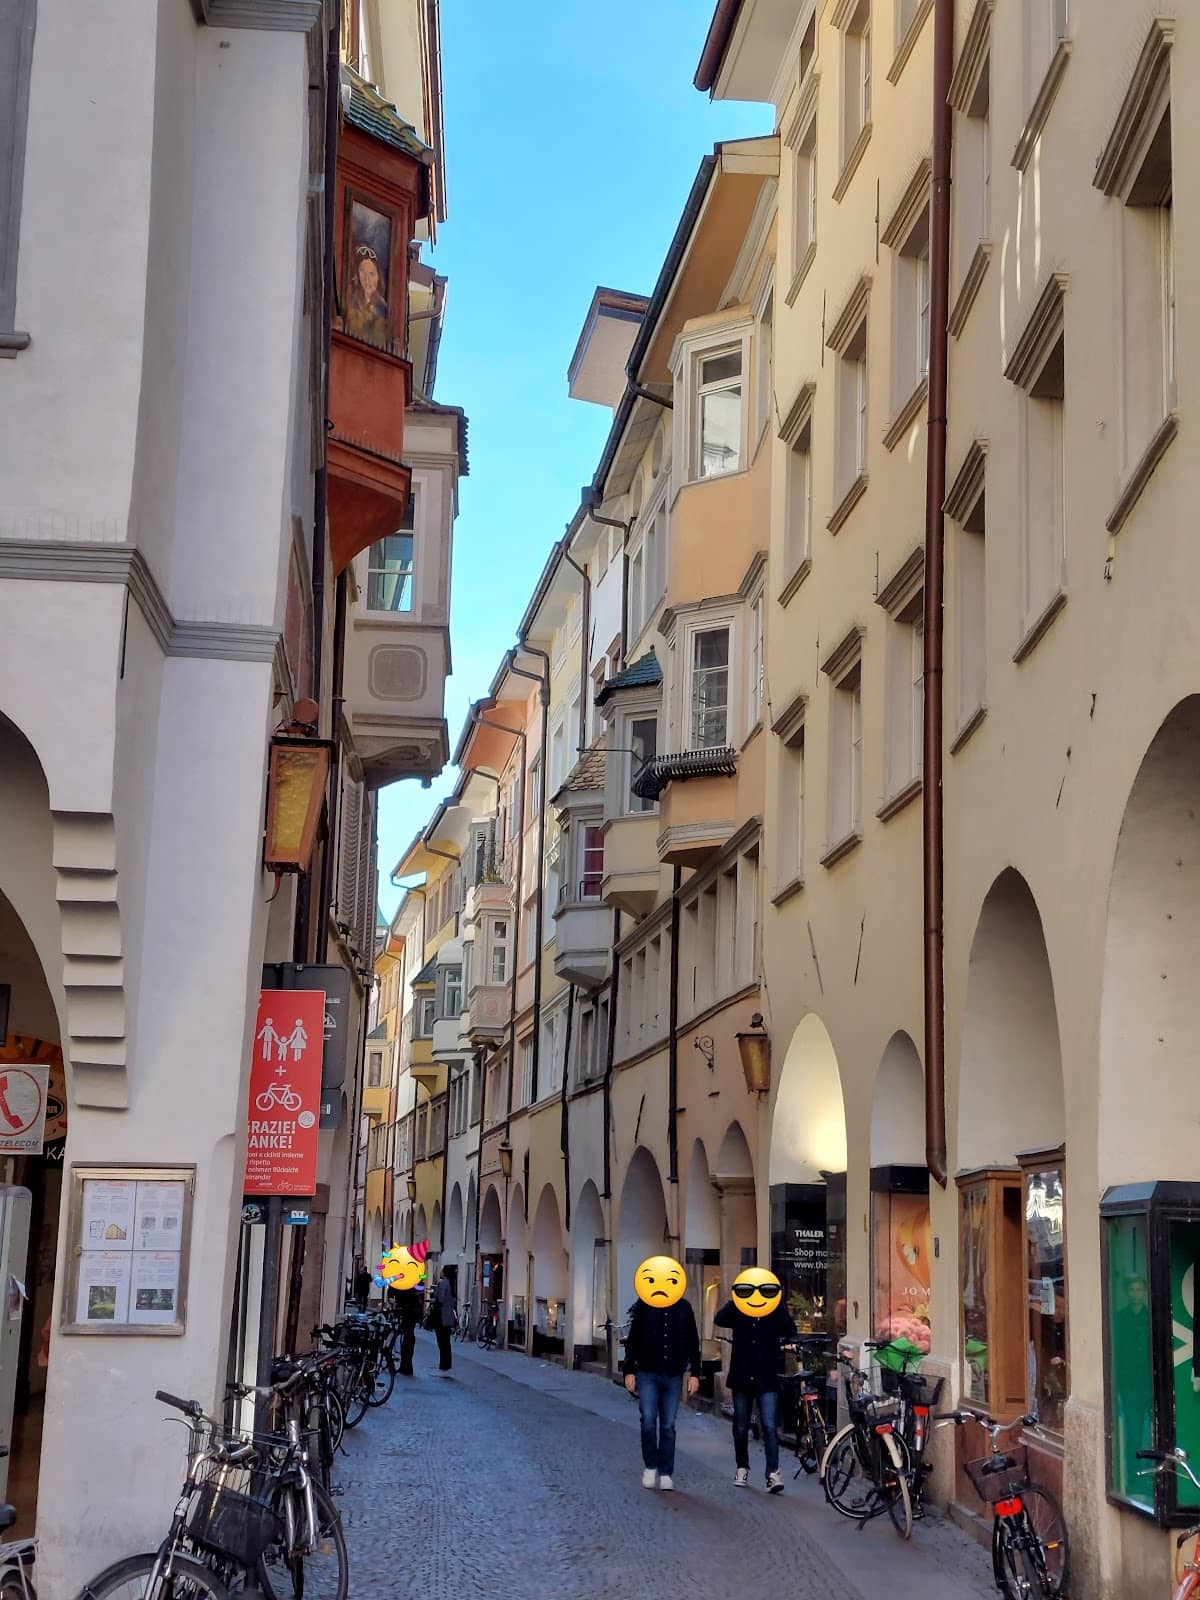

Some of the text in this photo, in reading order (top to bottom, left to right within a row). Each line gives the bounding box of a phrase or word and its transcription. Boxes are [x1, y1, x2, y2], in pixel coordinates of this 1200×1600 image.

[248, 1135, 292, 1149] ANKE!
[794, 1229, 824, 1238] THALER
[794, 1247, 814, 1259] Shop
